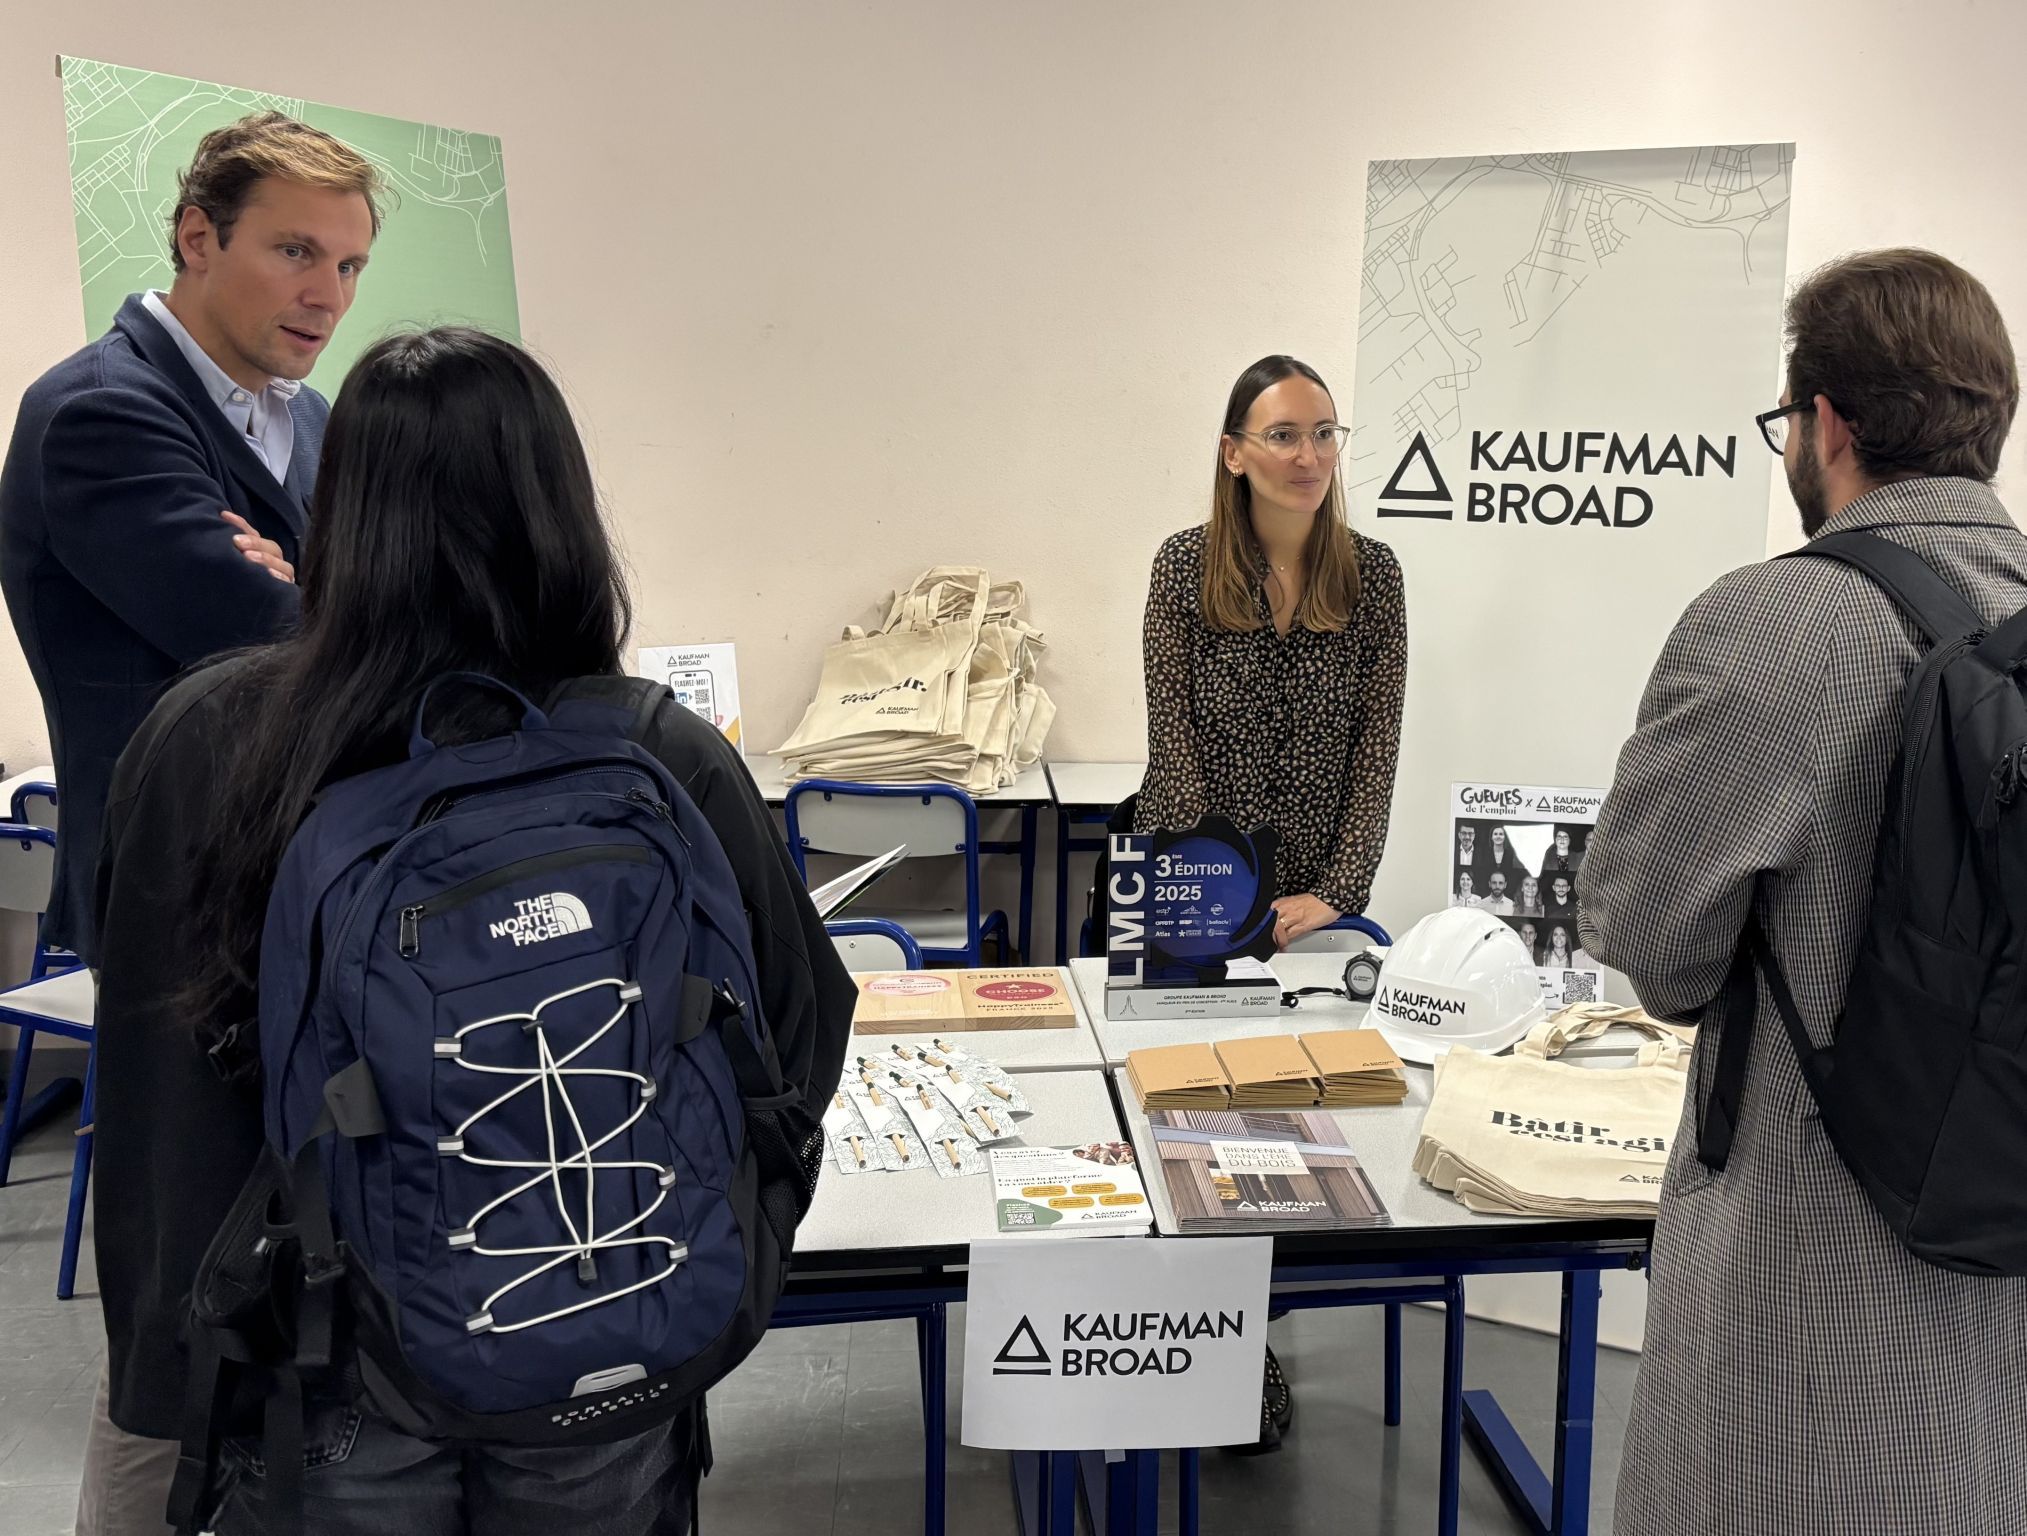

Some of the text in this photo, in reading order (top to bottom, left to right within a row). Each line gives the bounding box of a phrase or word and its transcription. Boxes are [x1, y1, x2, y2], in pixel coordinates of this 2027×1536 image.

[1470, 430, 1736, 478] KAUFMAN
[1467, 482, 1653, 528] BROAD
[1465, 805, 1517, 815] de l'emploi
[1553, 796, 1601, 806] KAUFMAN
[1553, 805, 1588, 814] BROAD
[1175, 862, 1233, 876] ÉDITION
[513, 894, 553, 915] THE
[1154, 885, 1202, 901] 2025
[1108, 835, 1146, 985] LMCF
[488, 908, 556, 939] NORTH
[511, 922, 561, 947] FACE
[967, 972, 1054, 980] CERTIFIED
[1393, 988, 1465, 1015] KAUFMAN
[1391, 1003, 1441, 1026] BROAD
[1489, 1110, 1611, 1137] Bâtir
[1223, 1146, 1289, 1154] BIENVENUE
[1594, 1137, 1668, 1153] agi
[1063, 1310, 1243, 1341] KAUFMAN
[1061, 1347, 1192, 1376] BROAD
